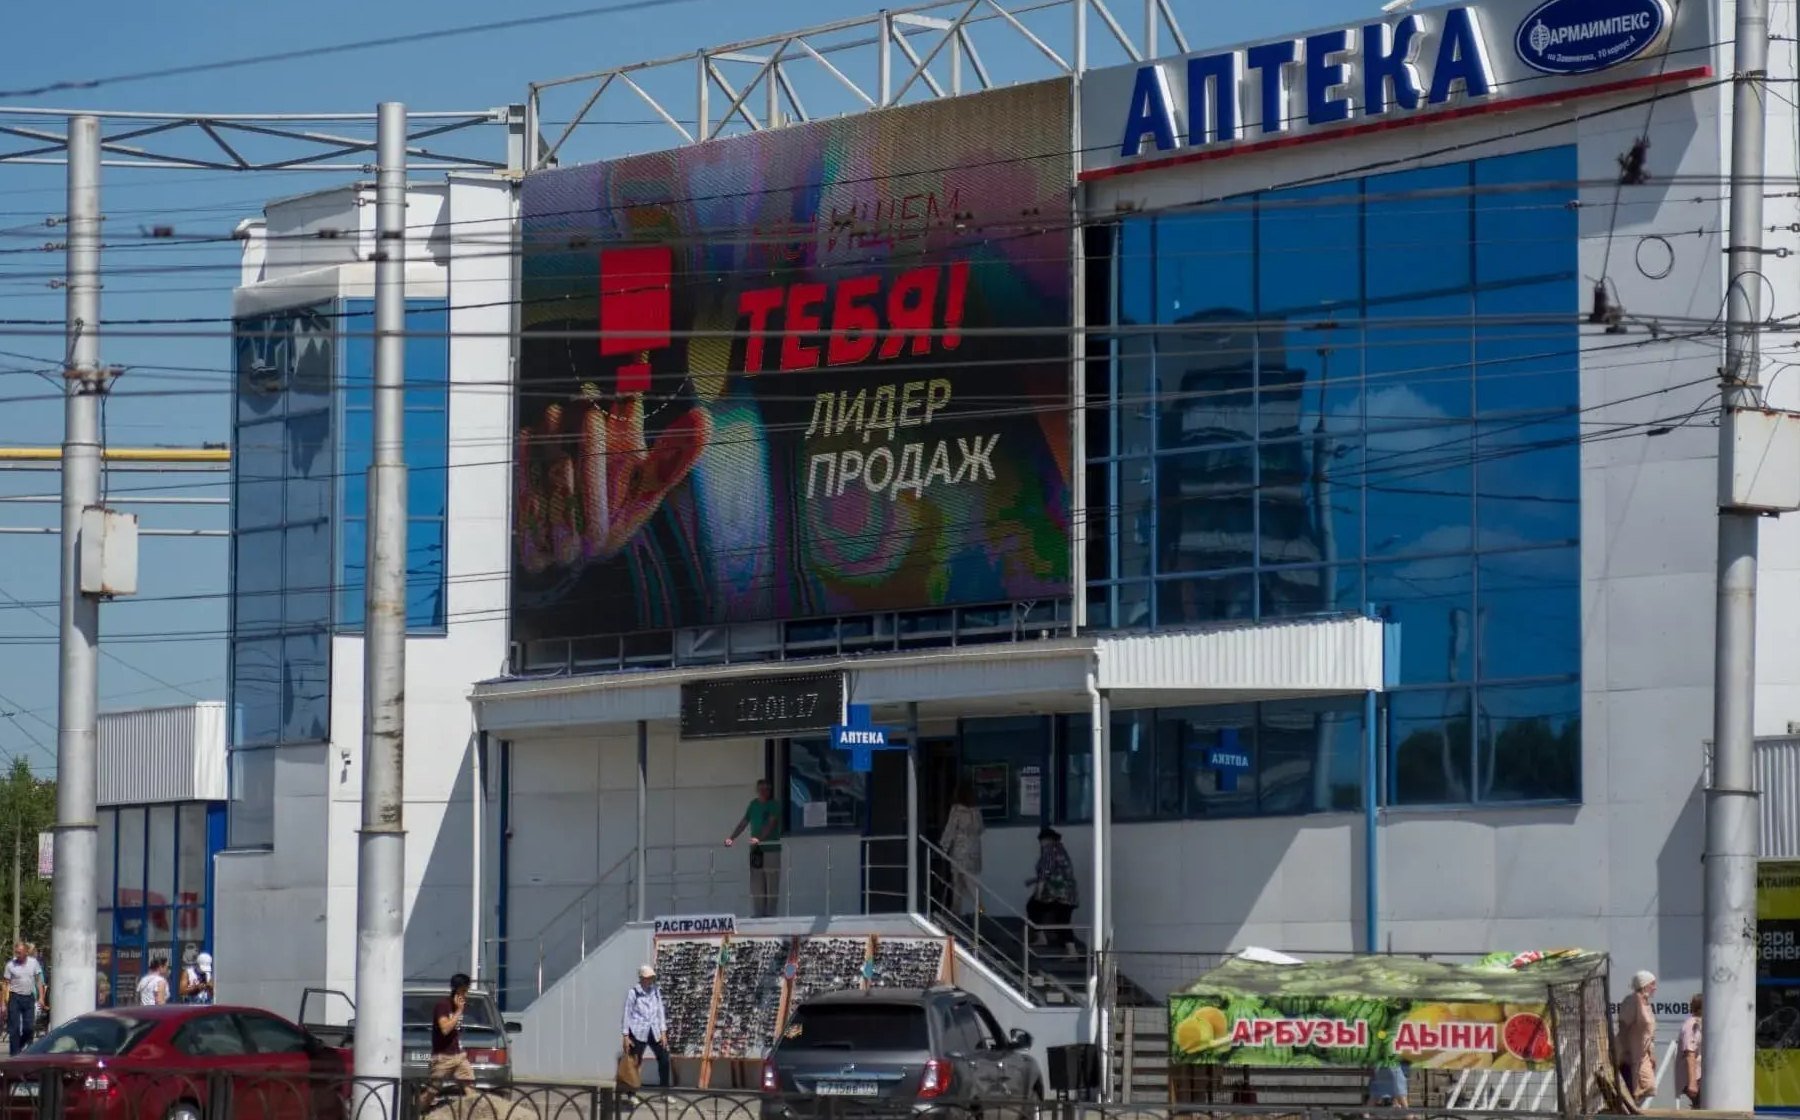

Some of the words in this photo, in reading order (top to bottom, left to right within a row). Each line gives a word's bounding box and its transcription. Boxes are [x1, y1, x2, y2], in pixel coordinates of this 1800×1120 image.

[1121, 6, 1496, 158] АПТЕКА
[738, 261, 969, 377] ТЕБЯ!
[804, 378, 952, 443] ЛИДЕР
[806, 433, 1000, 501] ПРОДАЖ
[840, 731, 884, 745] АПТЕКА
[655, 918, 734, 932] РАСПРОДАЖА
[1232, 1019, 1367, 1046] АРБУЗЫ
[1395, 1022, 1496, 1052] ДЫНИ
